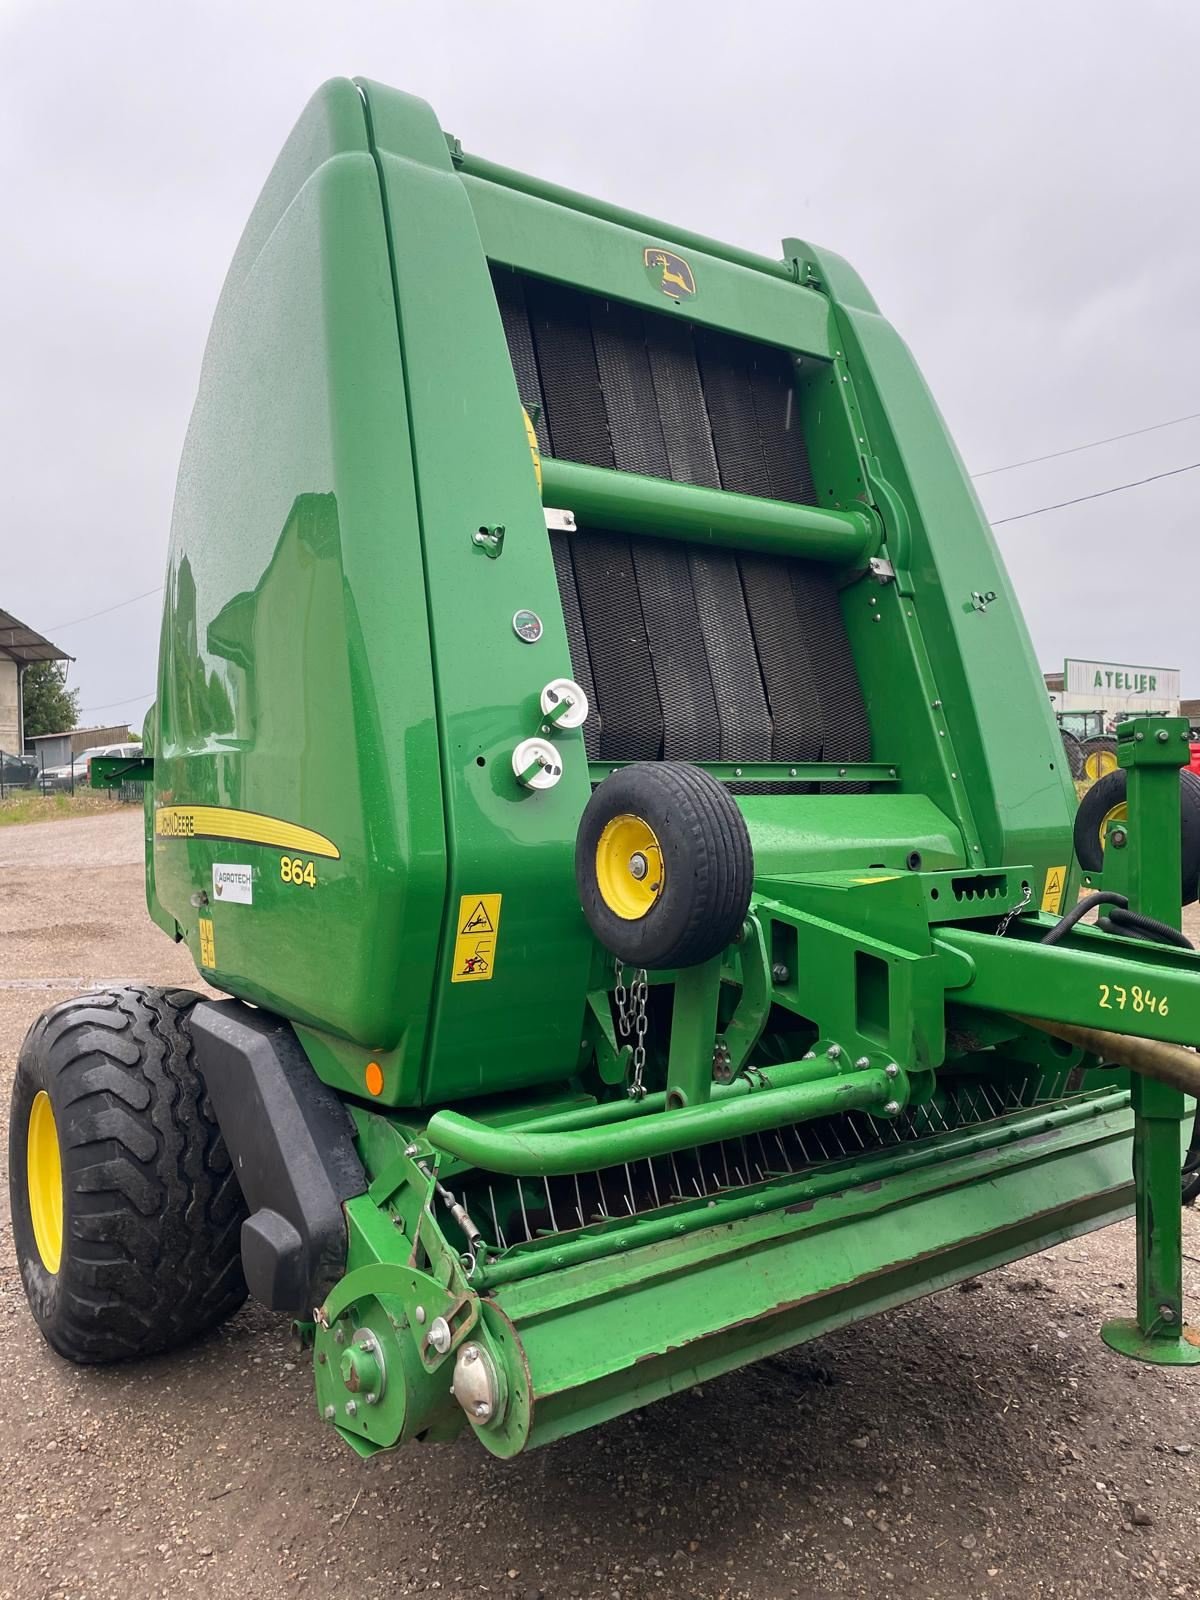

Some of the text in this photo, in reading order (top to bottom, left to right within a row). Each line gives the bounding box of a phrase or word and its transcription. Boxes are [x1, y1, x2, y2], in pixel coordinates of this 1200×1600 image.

[1094, 670, 1156, 692] ATELIER
[218, 871, 251, 885] AGROTECH
[280, 855, 317, 889] 864
[1099, 984, 1169, 1017] 27846
